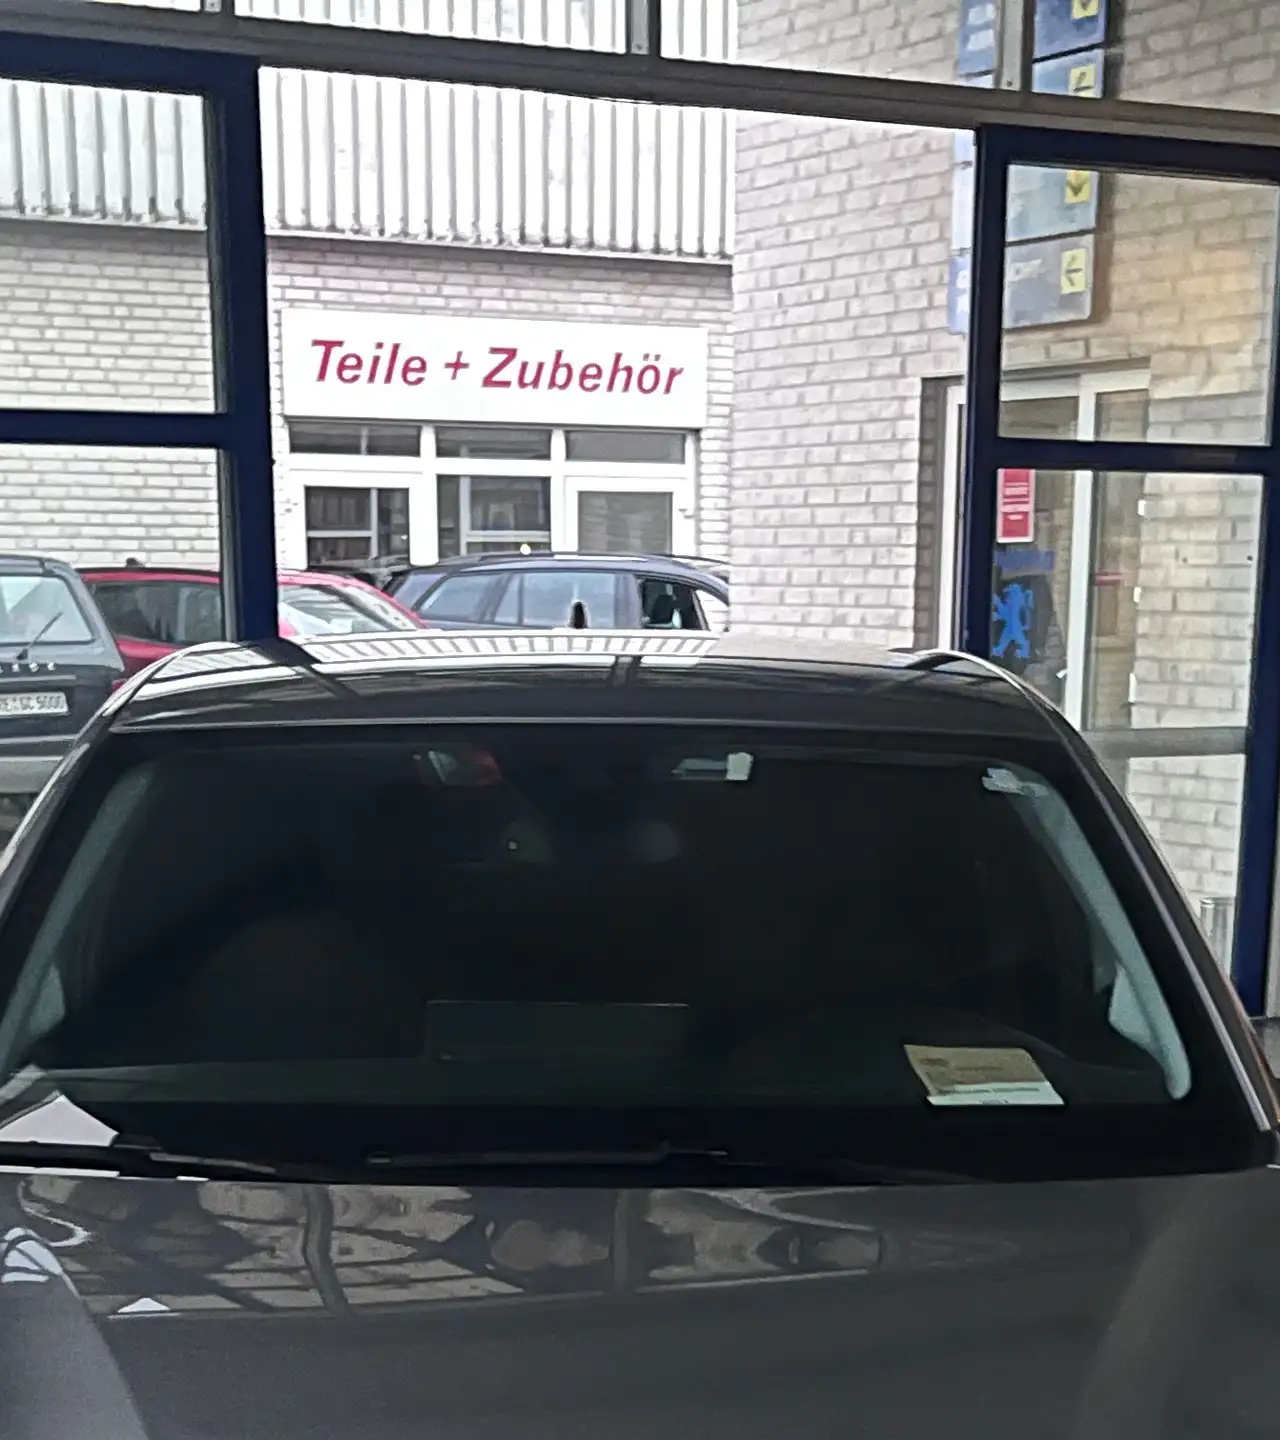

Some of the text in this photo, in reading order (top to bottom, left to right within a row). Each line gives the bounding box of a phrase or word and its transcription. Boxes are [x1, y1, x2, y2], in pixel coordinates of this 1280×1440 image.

[311, 339, 683, 395] Teile + Zubehör
